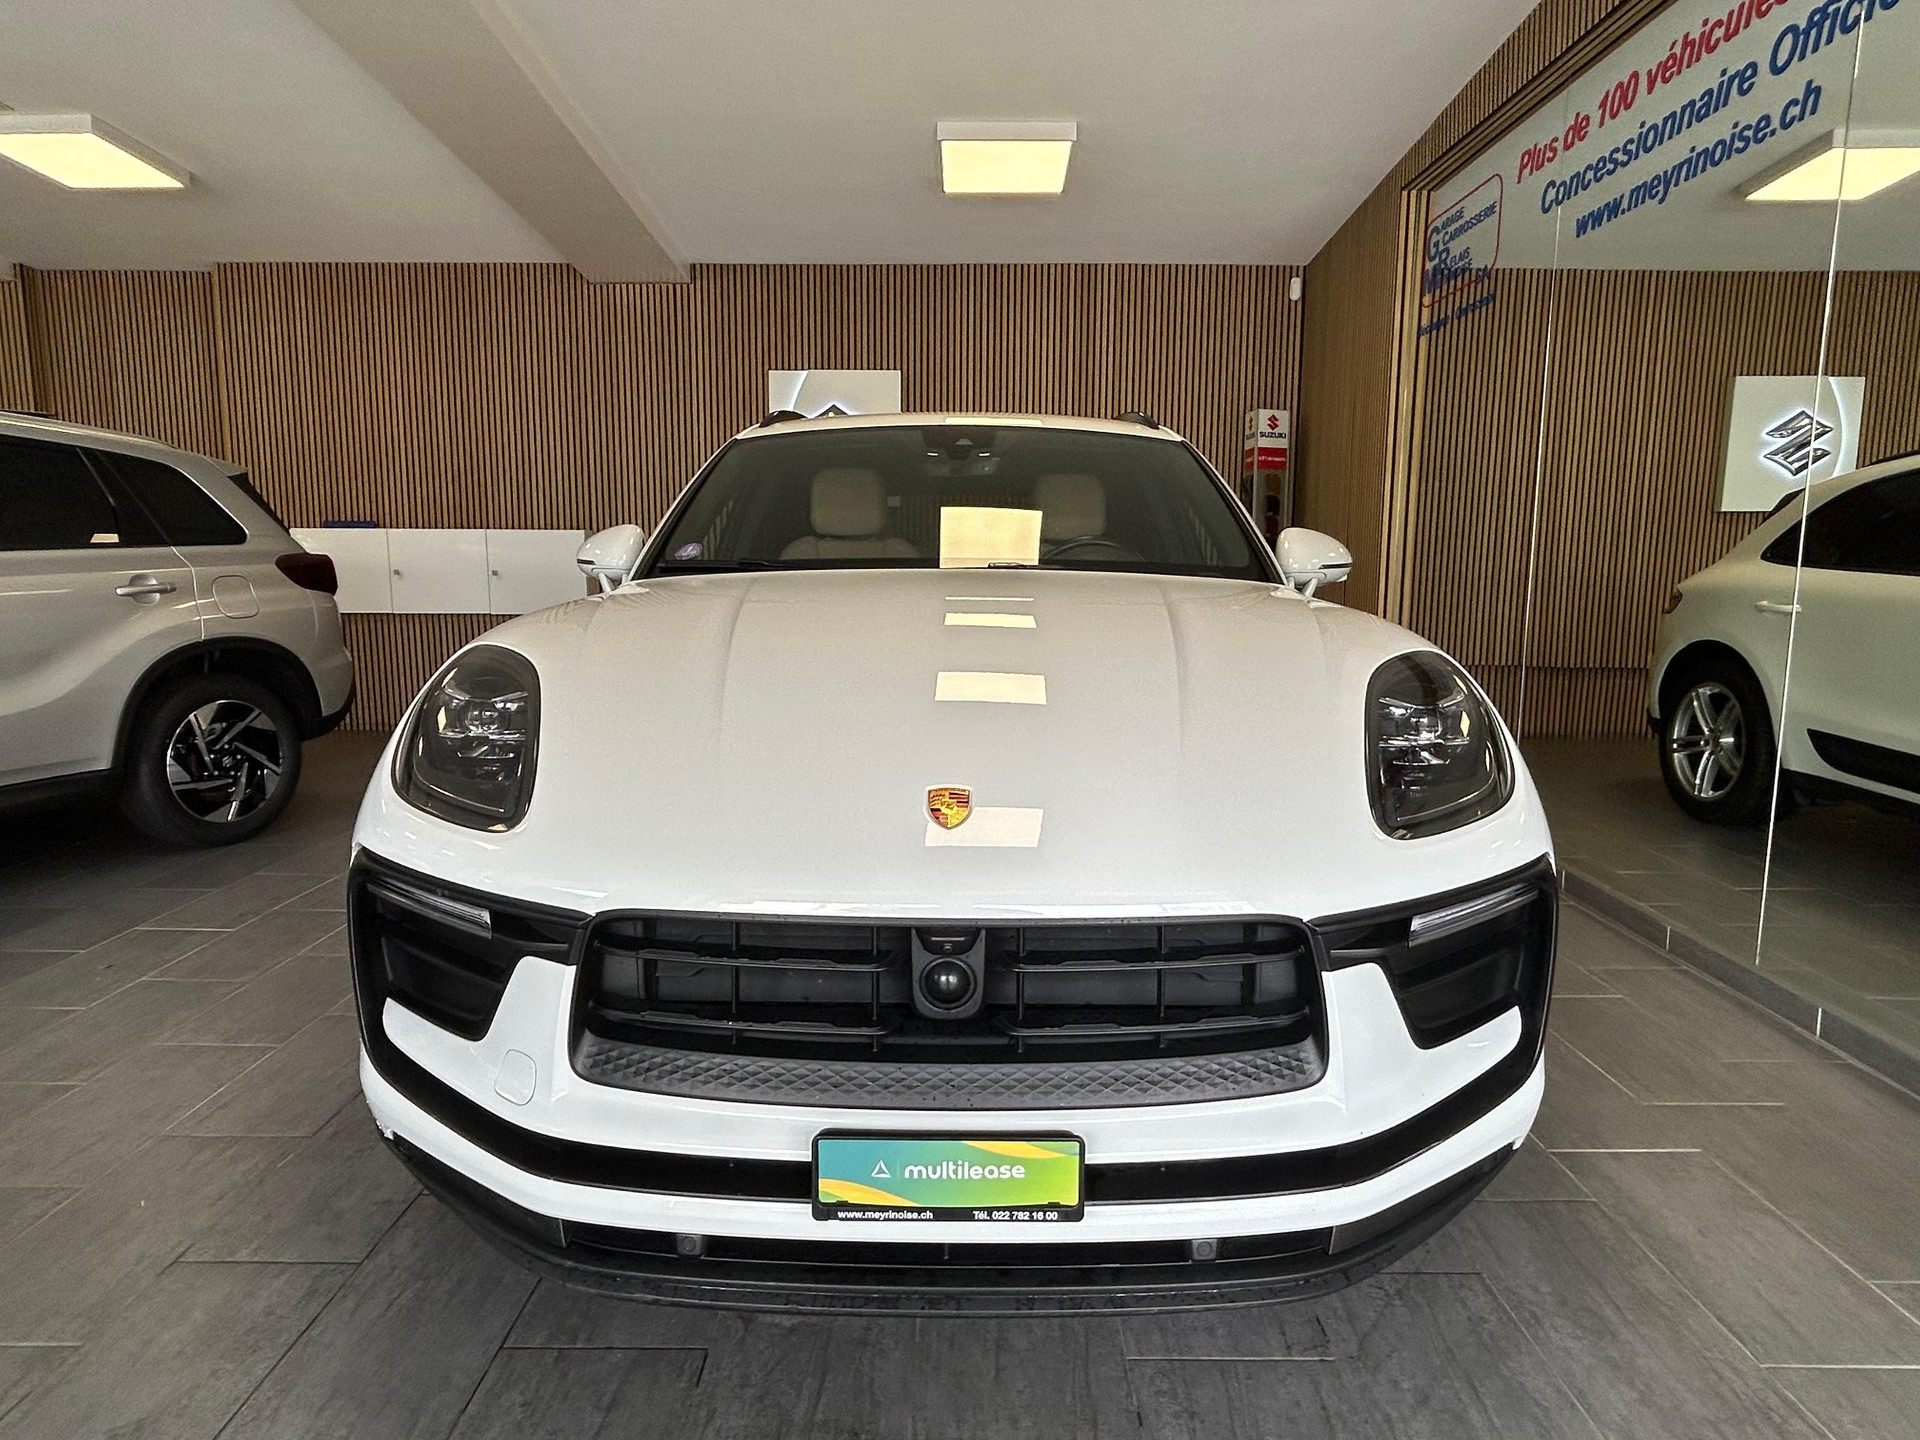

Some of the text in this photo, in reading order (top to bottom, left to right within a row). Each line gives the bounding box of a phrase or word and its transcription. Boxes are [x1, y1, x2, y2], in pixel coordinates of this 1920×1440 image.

[1517, 136, 1559, 184] Plus
[1563, 112, 1591, 151] de
[1598, 70, 1640, 129] 100
[1541, 60, 1758, 214] Concessionnaire
[1575, 79, 1822, 238] www.meyrinoise.ch
[1259, 431, 1287, 440] SUZUKI
[904, 1160, 1026, 1180] multilease
[837, 1210, 1059, 1220] www.meyrinoise.ch Tél. 022 782 16 00
